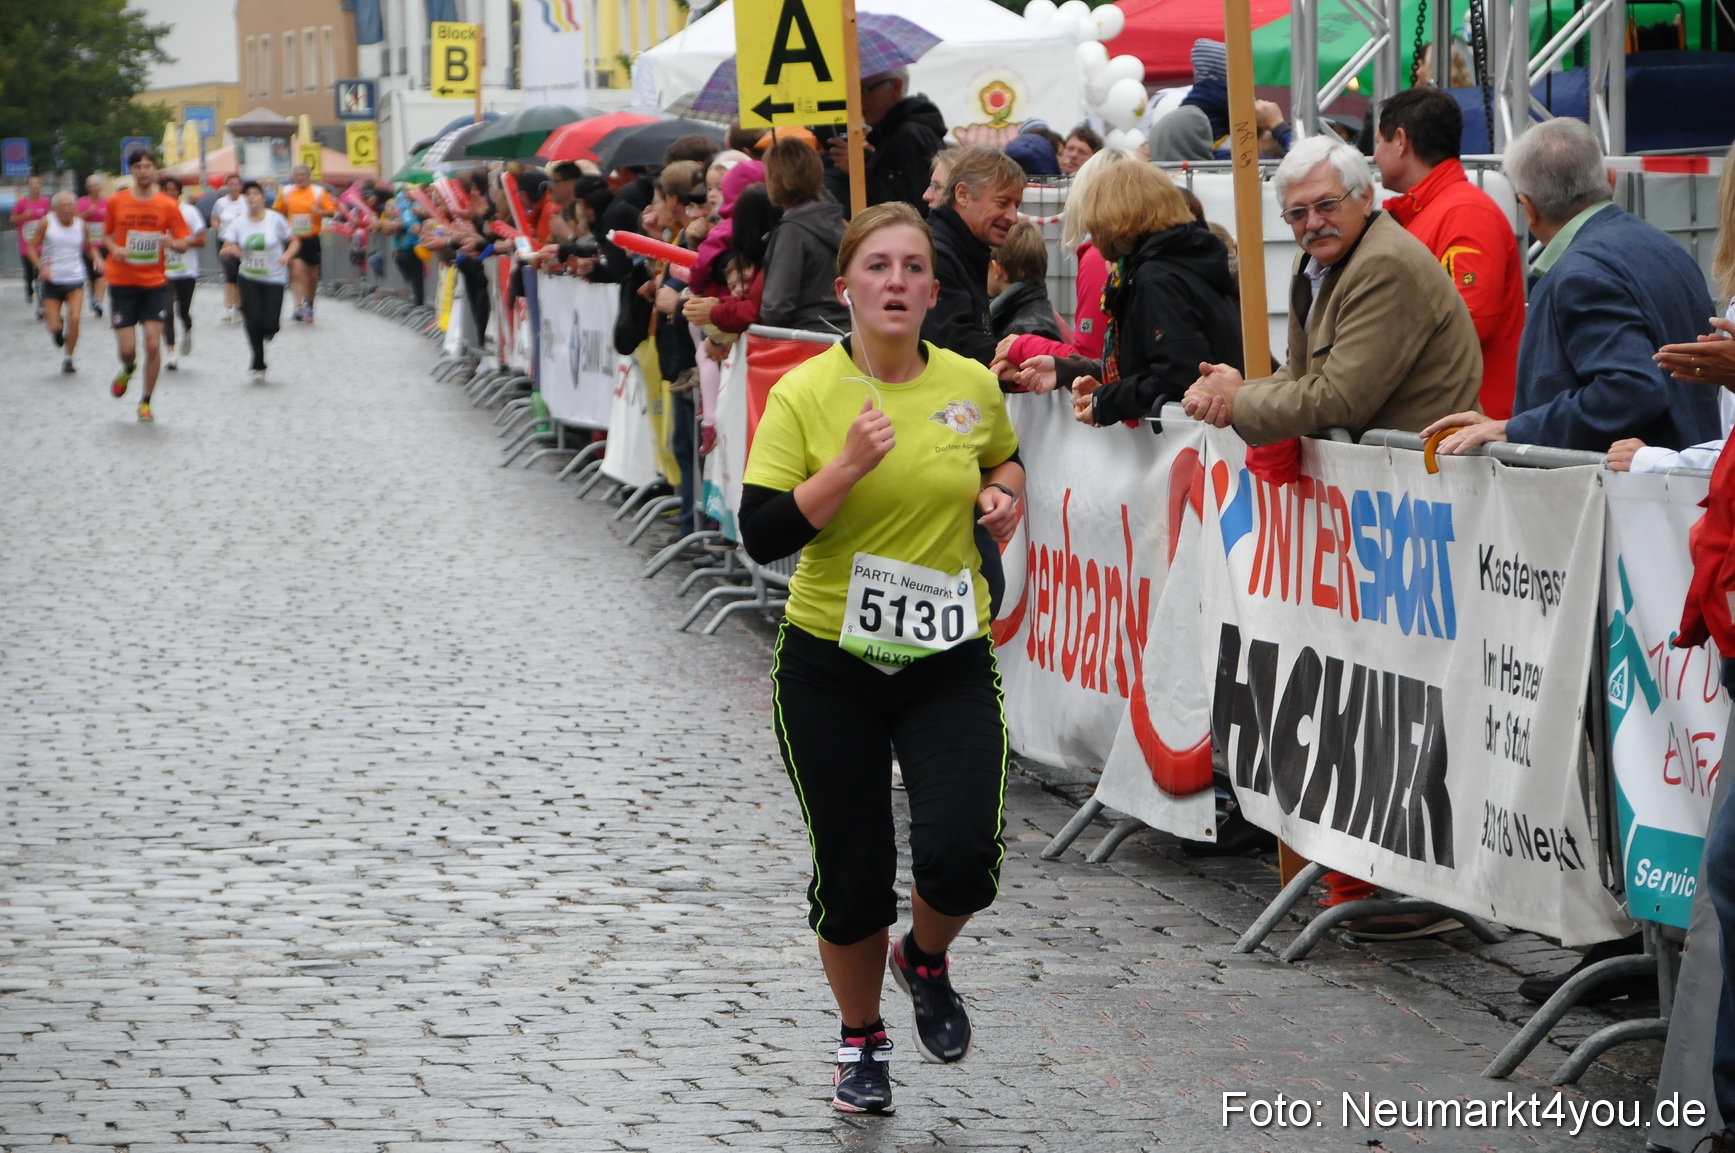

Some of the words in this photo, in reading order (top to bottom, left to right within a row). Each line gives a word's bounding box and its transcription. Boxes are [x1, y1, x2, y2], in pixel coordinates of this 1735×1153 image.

[437, 25, 477, 40] Block
[763, 0, 833, 85] A
[446, 46, 468, 81] B
[354, 134, 370, 157] C
[1248, 474, 1457, 640] INTERSPORT
[854, 565, 898, 586] PARTL
[900, 575, 954, 599] Neumarkt
[859, 586, 964, 642] 5130
[1635, 858, 1698, 898] Servic
